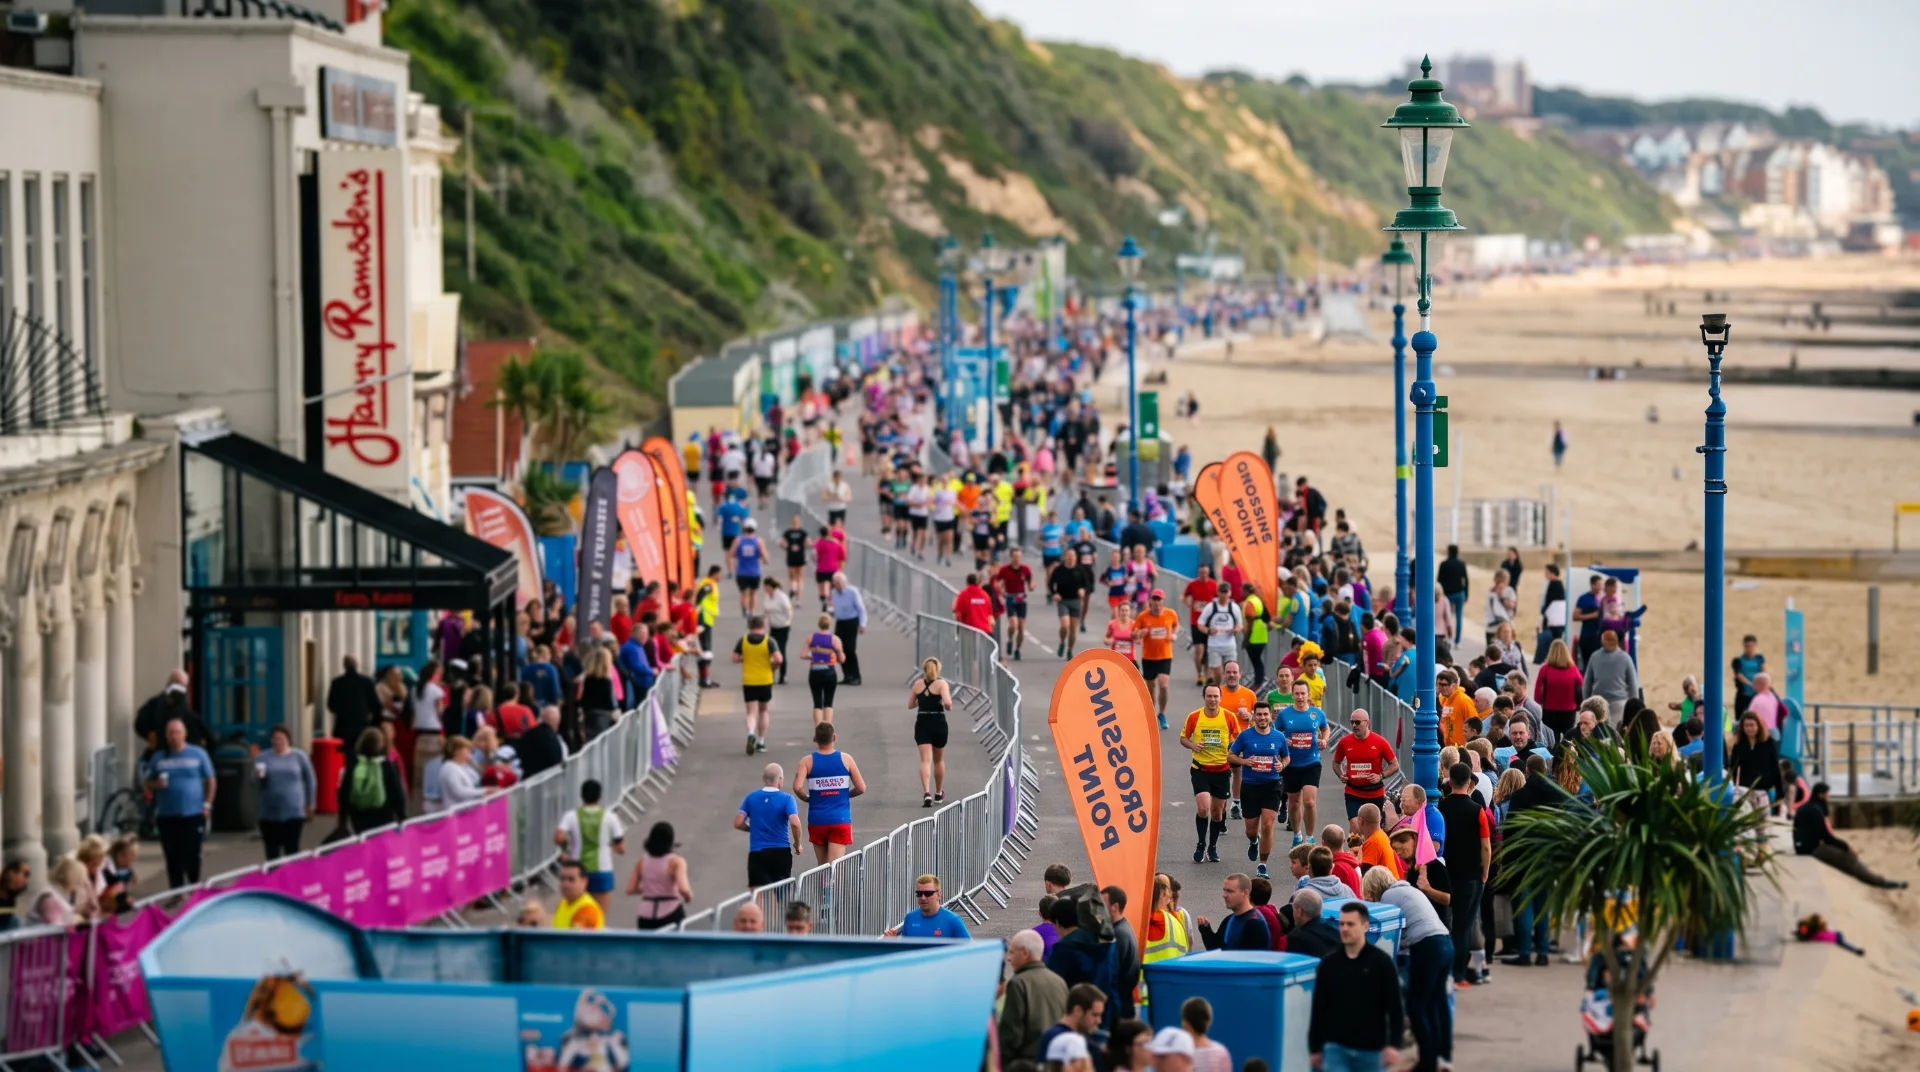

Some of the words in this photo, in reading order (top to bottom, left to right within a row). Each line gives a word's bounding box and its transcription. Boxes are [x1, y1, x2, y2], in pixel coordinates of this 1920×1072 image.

[323, 169, 374, 340] Ramsden's
[326, 341, 400, 467] Harry
[1233, 498, 1259, 546] POINT
